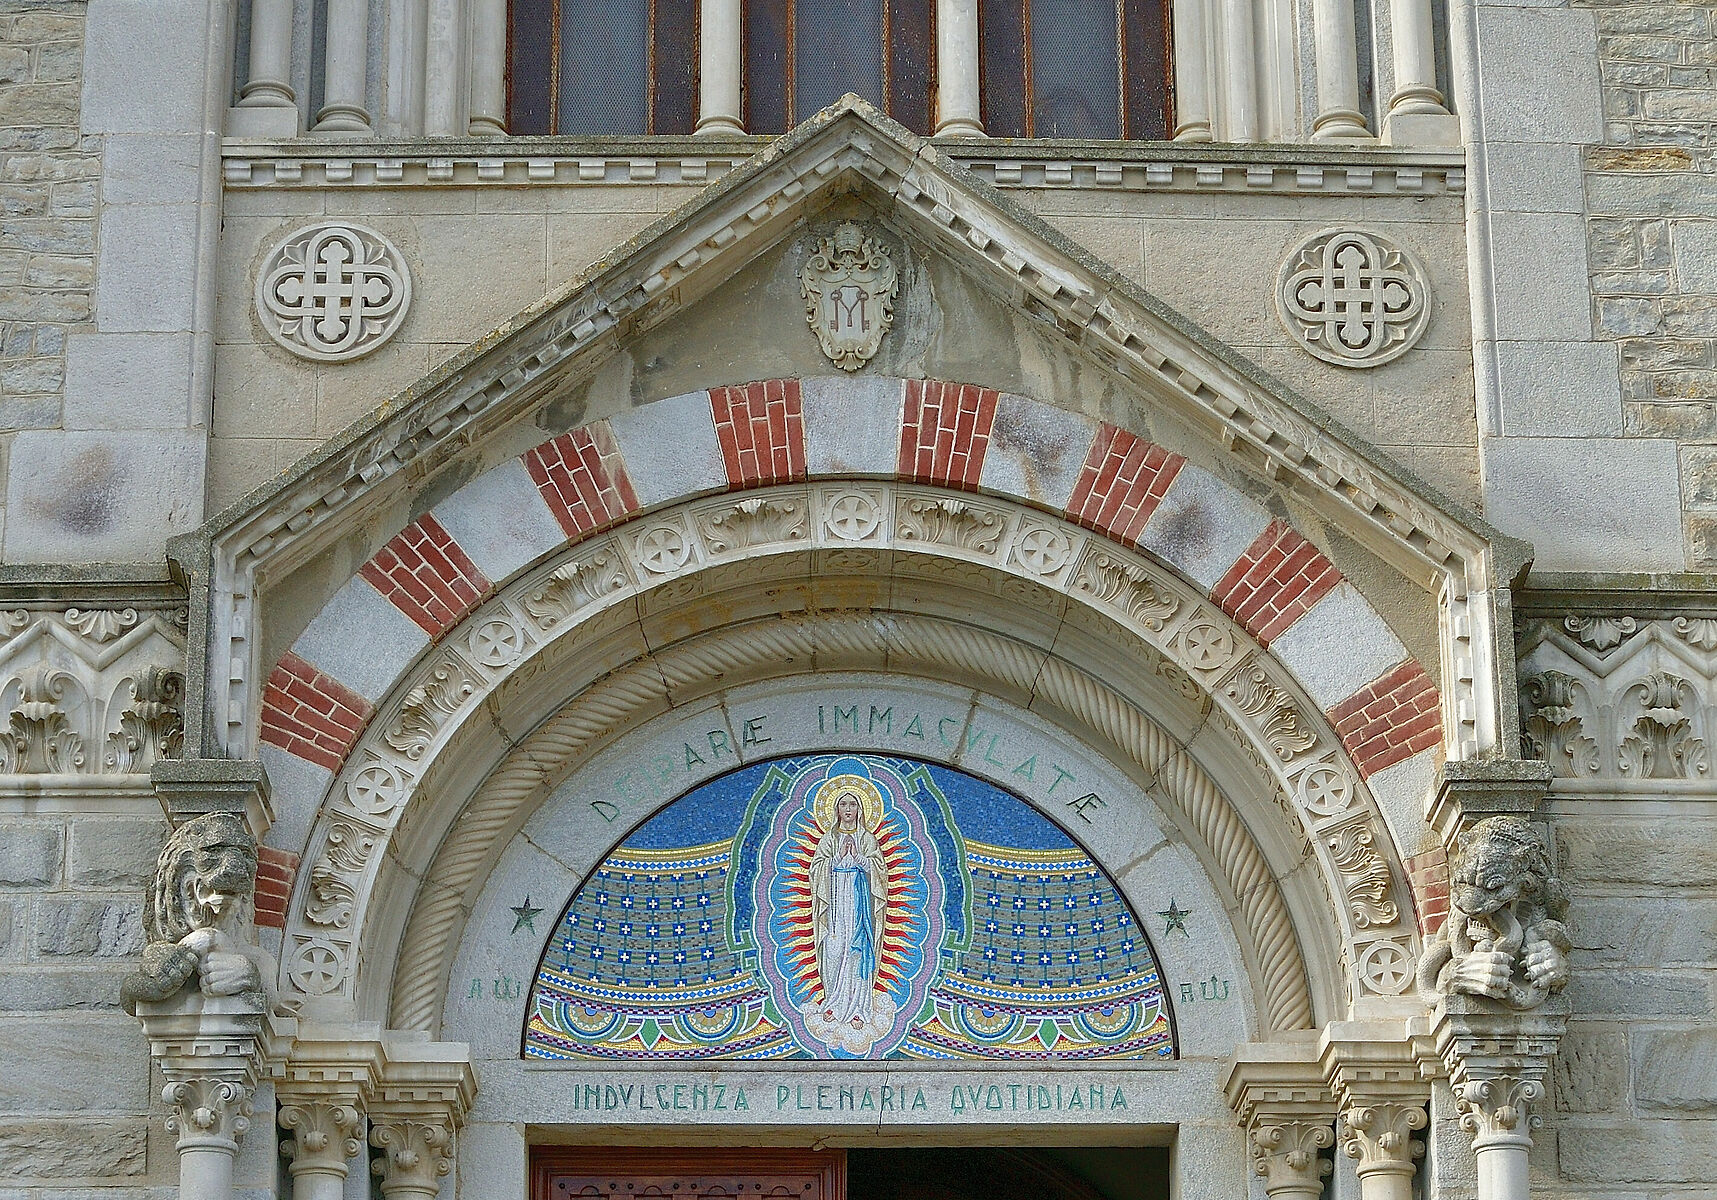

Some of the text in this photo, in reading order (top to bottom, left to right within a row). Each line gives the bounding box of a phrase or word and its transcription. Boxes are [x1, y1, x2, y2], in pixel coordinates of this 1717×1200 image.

[574, 1084, 1128, 1116] INDVLGENZA PLENARIA QVOTIDIANA
